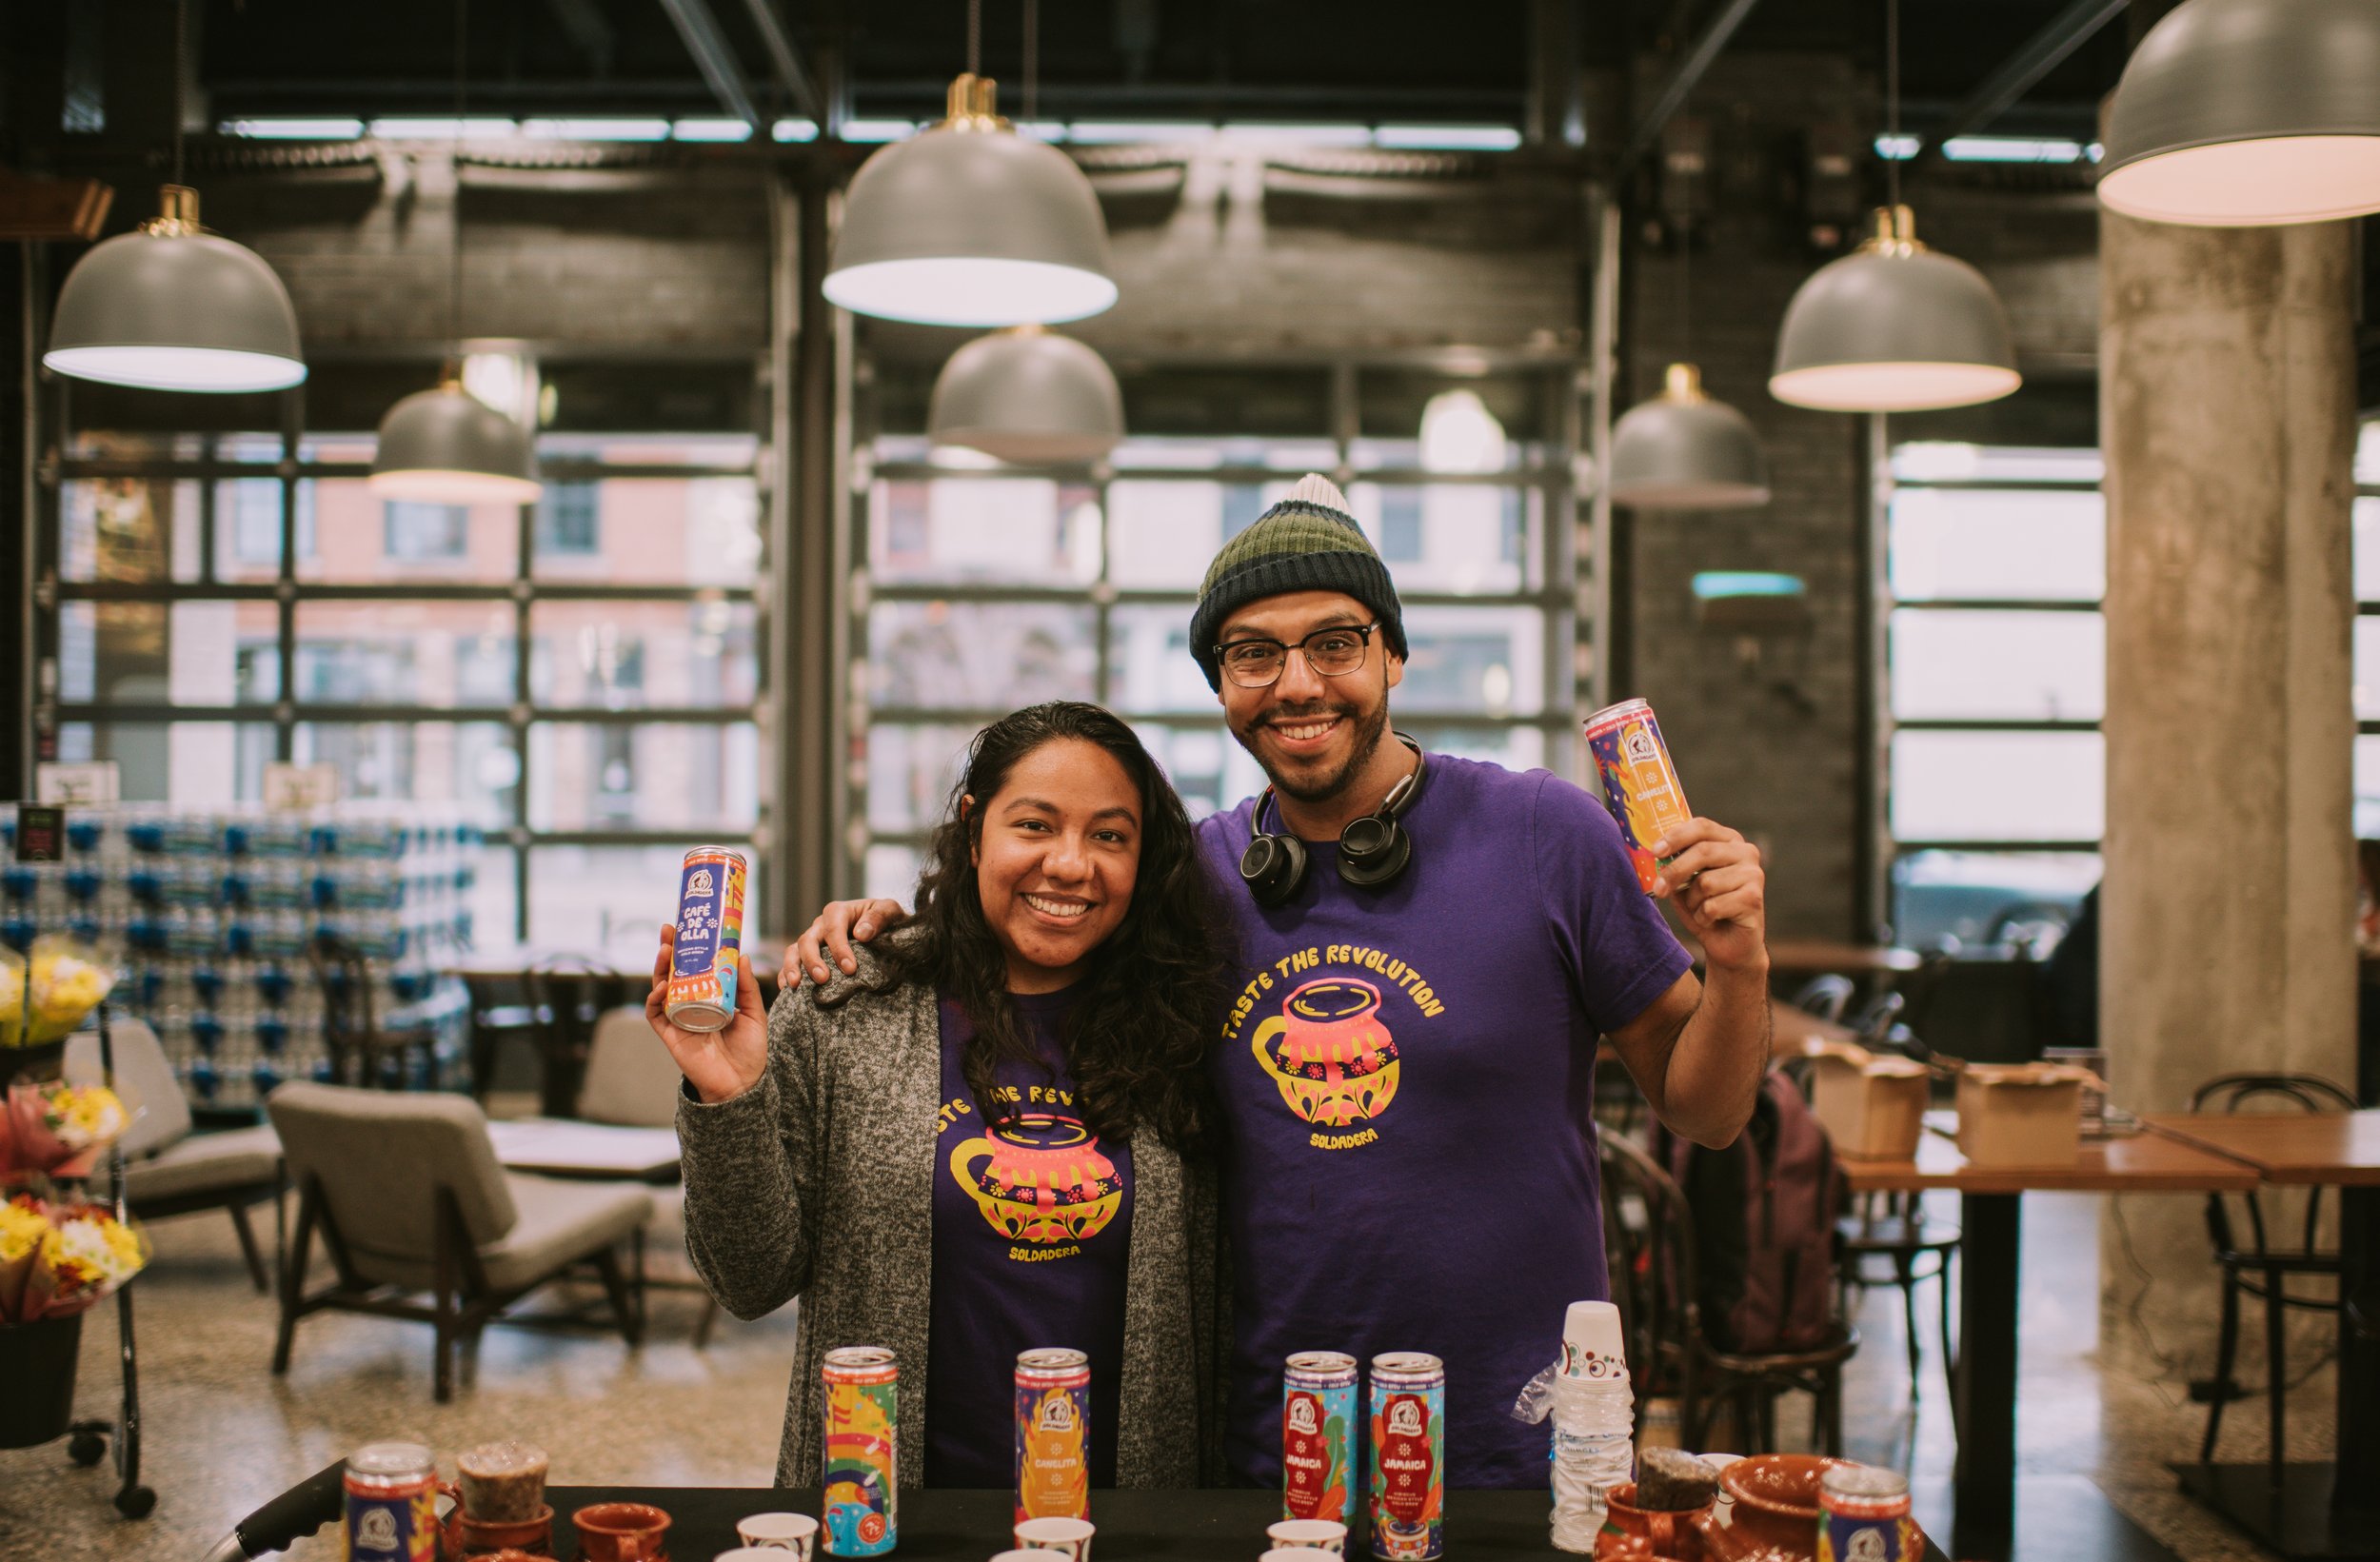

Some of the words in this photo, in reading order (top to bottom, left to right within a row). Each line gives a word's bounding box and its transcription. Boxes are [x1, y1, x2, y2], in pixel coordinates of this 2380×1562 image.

[684, 902, 711, 919] CAFÉ
[688, 917, 704, 929] DE
[681, 929, 710, 940] OLLA
[1221, 972, 1274, 1039] TASTE
[1276, 947, 1319, 979] THE
[1326, 944, 1445, 1018] REVOLUTION
[1310, 1127, 1378, 1150] SOLDADERA
[1009, 1245, 1081, 1262] SOLDADERA
[1035, 1458, 1077, 1470] CANELITA
[1286, 1454, 1321, 1470] JAMAICA
[1384, 1458, 1426, 1471] JAMAICA
